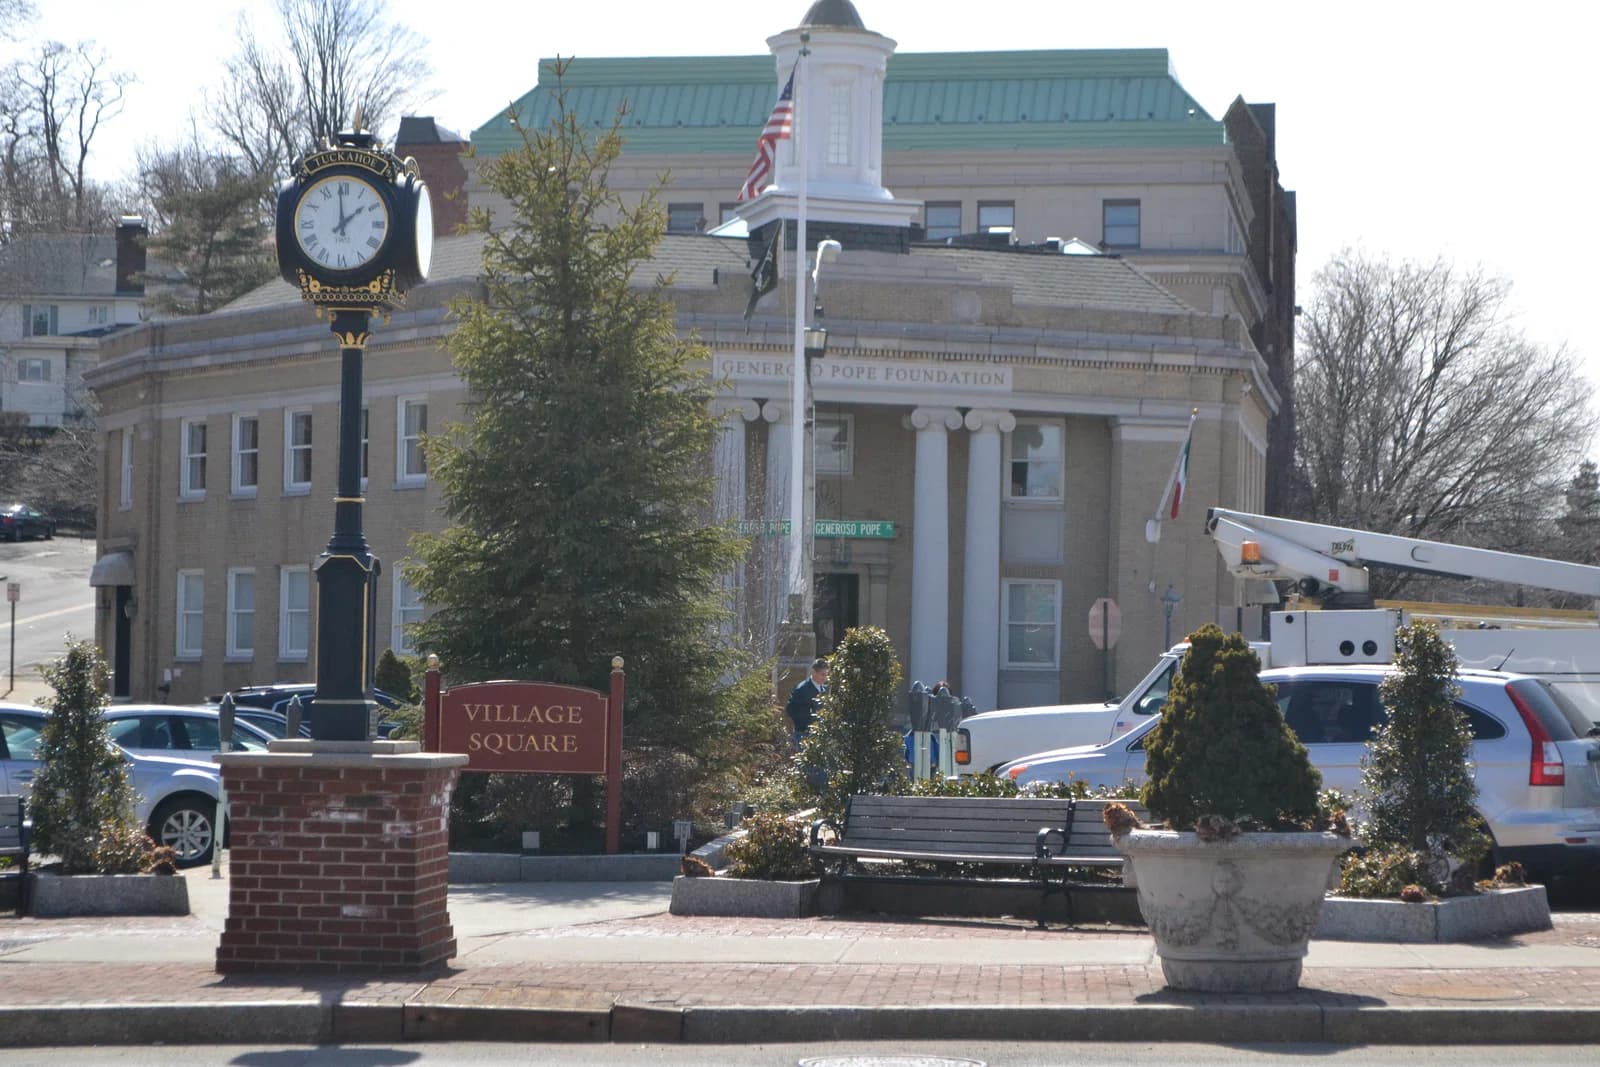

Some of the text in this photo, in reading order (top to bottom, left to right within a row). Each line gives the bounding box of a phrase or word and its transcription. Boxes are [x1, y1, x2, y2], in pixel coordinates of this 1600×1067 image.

[314, 151, 377, 168] TUCKAHOE
[721, 359, 1005, 385] GENEROO POPE FOUNDATION
[815, 522, 856, 535] GENEROSO
[860, 523, 881, 535] POPE
[463, 704, 583, 724] VILLAGE
[468, 732, 578, 755] SQUARE
